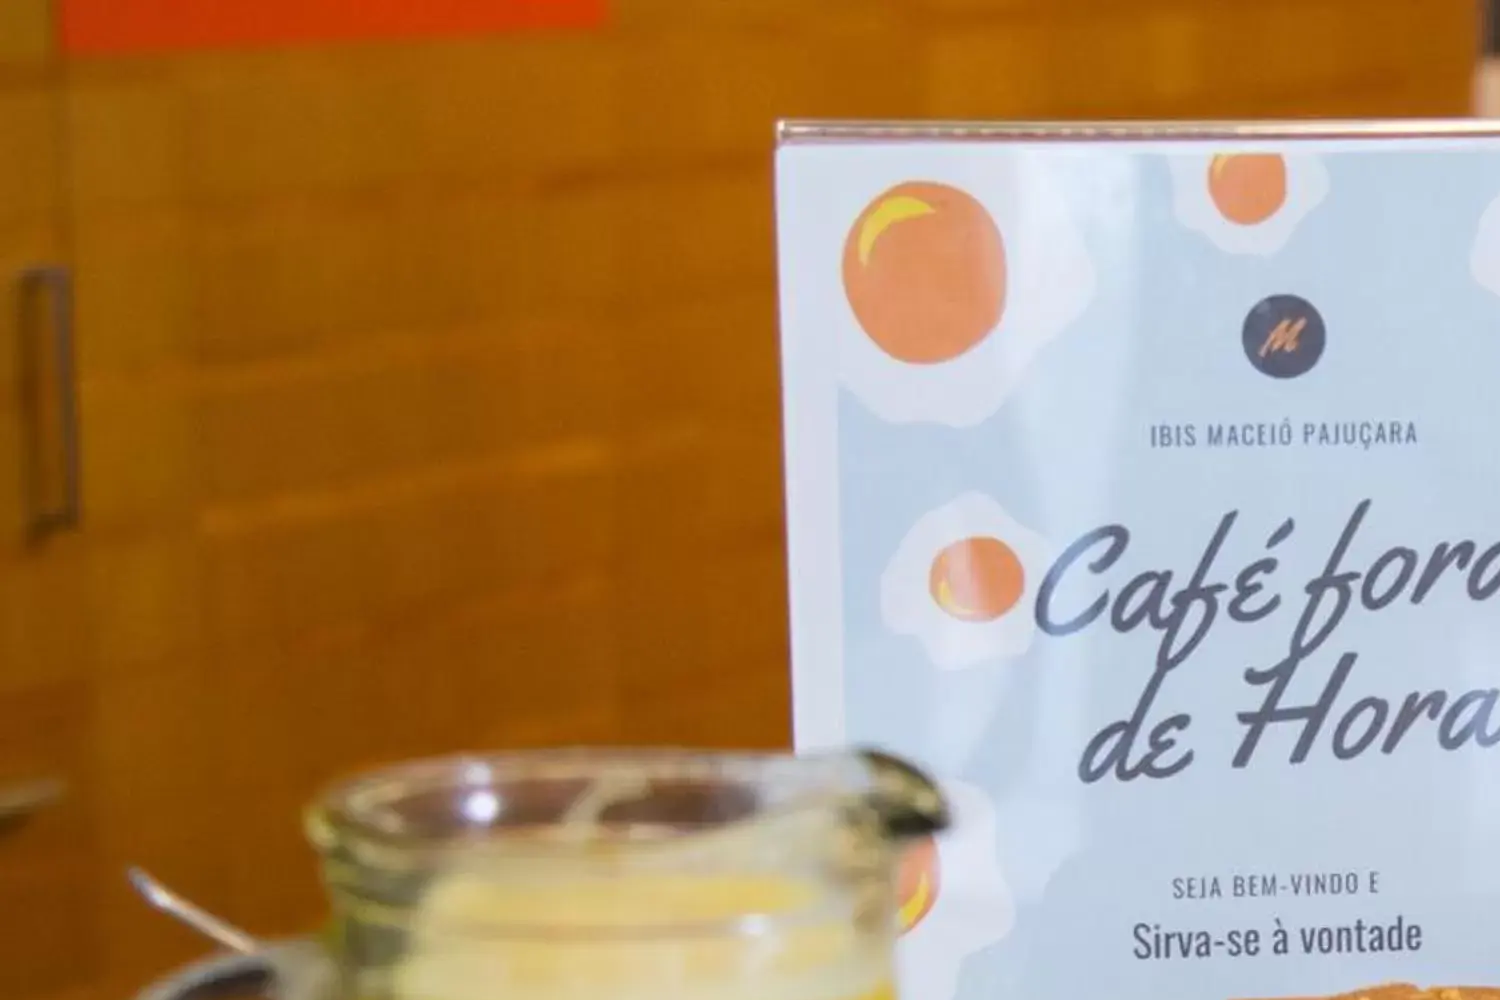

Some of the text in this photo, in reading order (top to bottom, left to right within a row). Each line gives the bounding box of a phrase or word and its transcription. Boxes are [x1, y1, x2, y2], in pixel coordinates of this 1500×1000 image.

[1150, 417, 1418, 450] IBIS MACEIÓ PAJUÇARA
[1033, 508, 1296, 673] Café
[1076, 660, 1195, 785] de
[1172, 871, 1379, 900] SEJA BEM-VINDO E
[1132, 914, 1423, 961] Sirva-se à vontade
